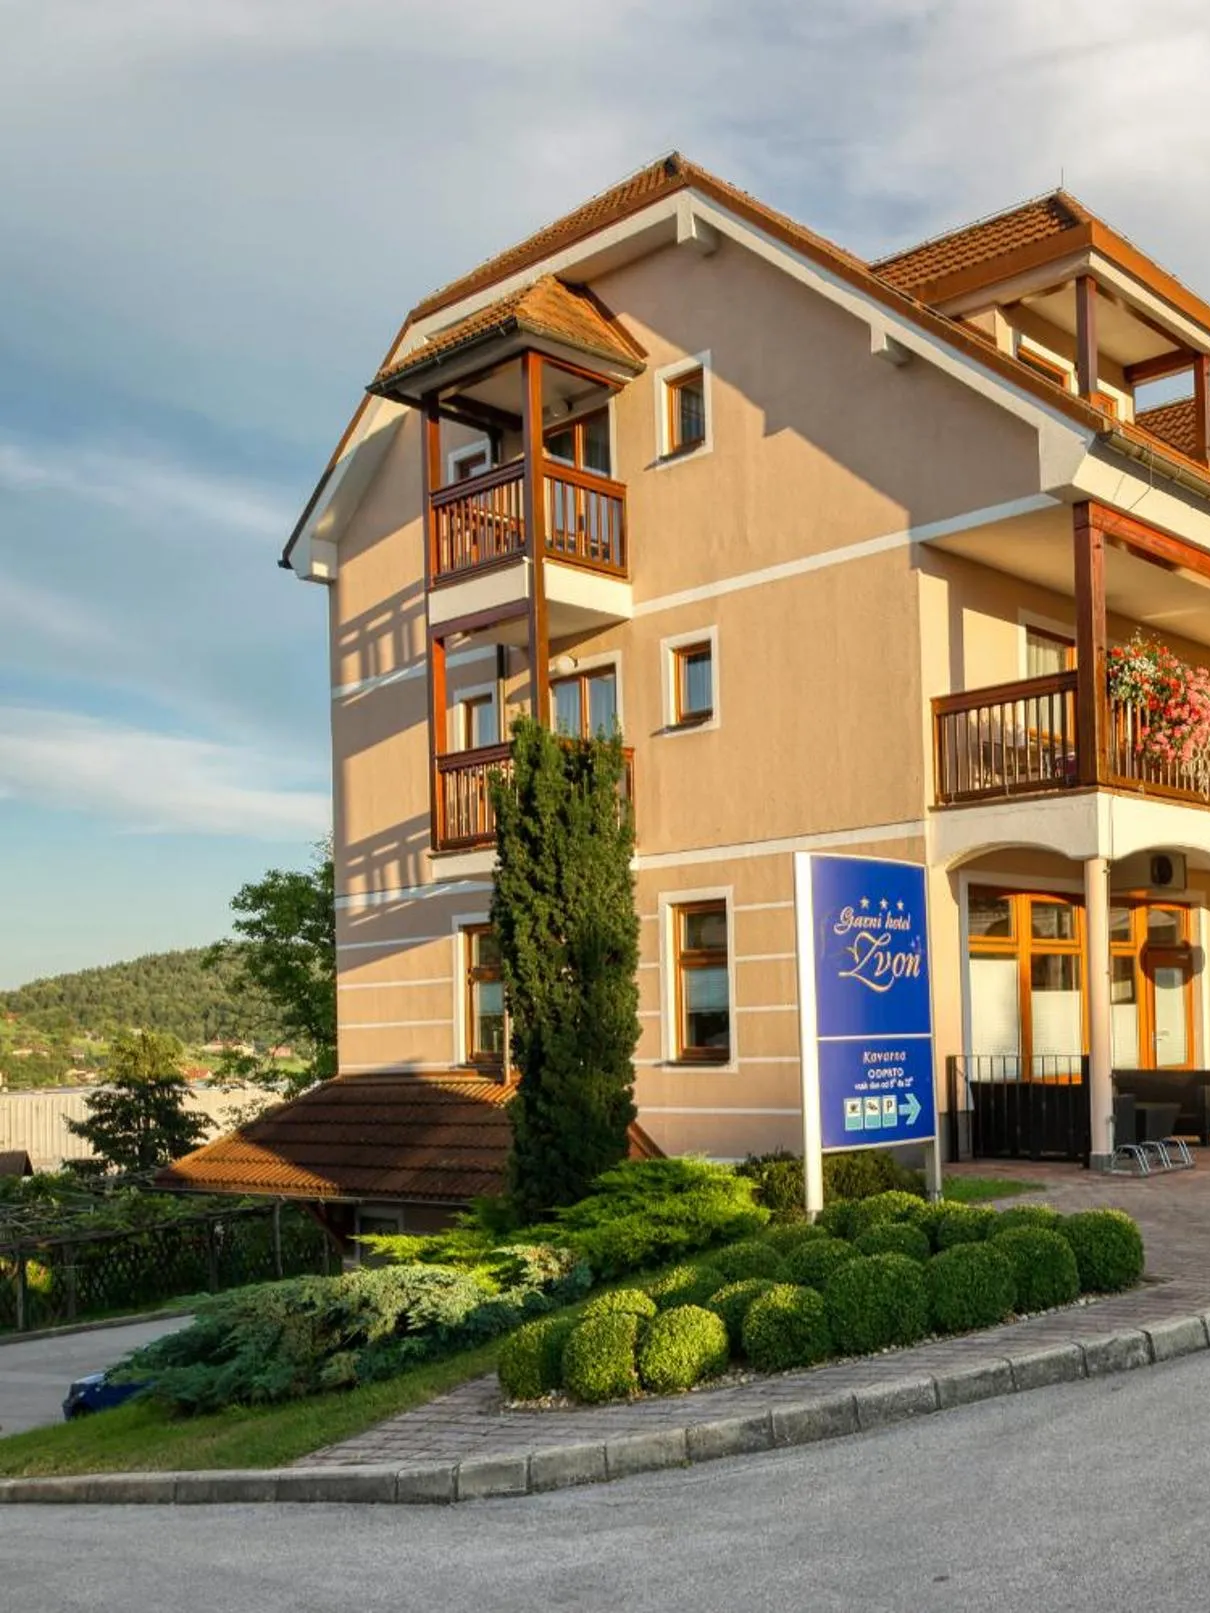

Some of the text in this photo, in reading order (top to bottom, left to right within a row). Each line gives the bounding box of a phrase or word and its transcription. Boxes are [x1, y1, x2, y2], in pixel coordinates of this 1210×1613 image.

[834, 906, 911, 935] Garni hotel
[838, 932, 921, 992] Zvon
